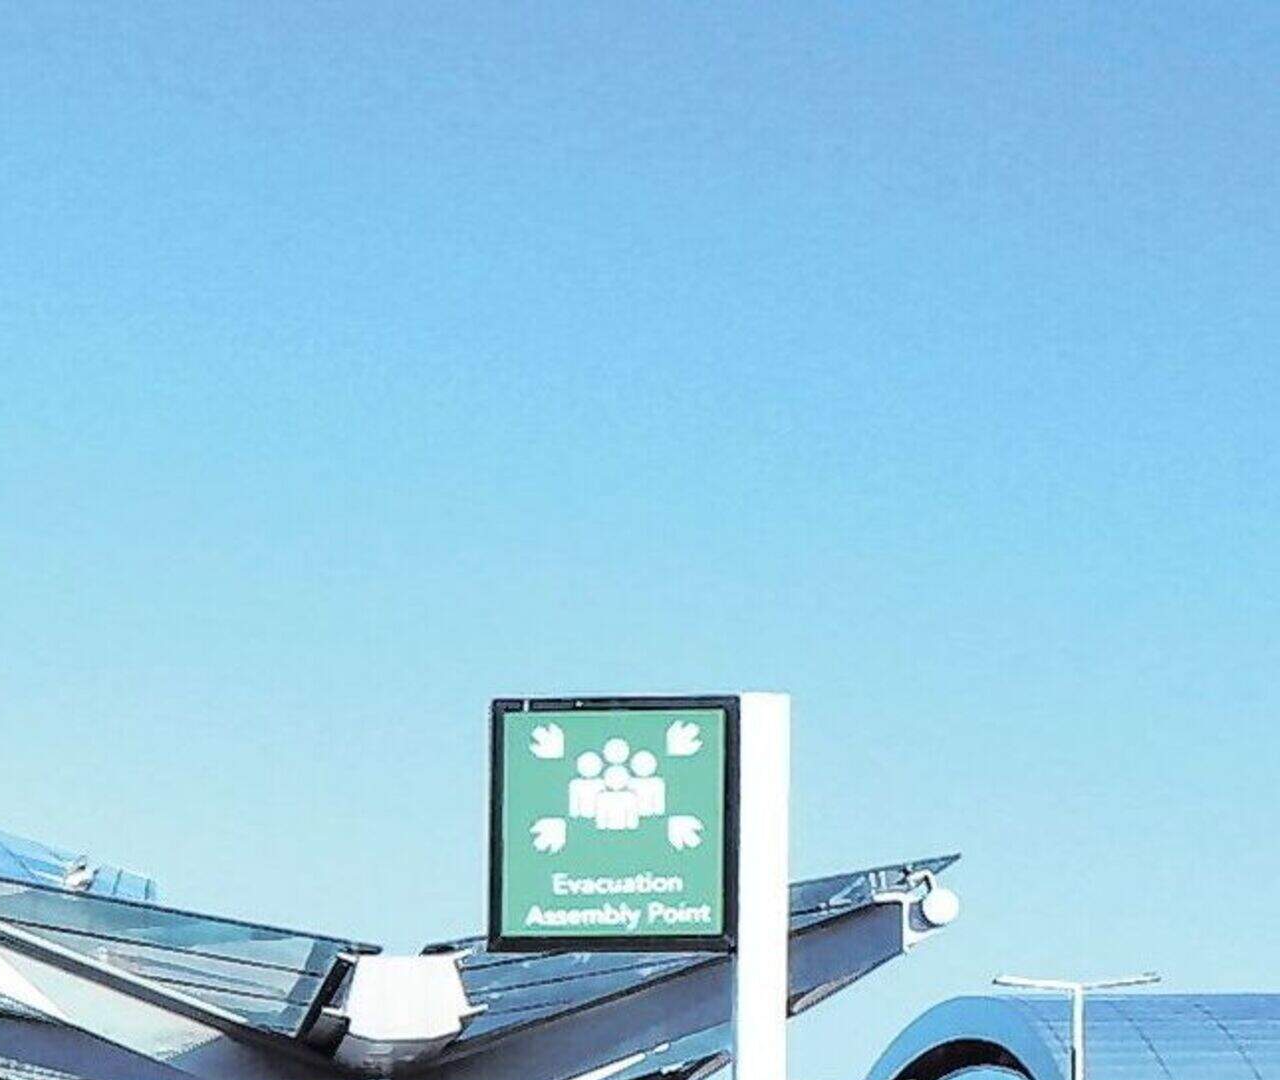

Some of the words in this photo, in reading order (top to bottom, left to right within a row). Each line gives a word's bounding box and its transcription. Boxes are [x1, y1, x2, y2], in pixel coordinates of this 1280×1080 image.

[552, 872, 683, 896] Evacuation
[525, 901, 640, 930] Assembly
[647, 901, 712, 924] Point
